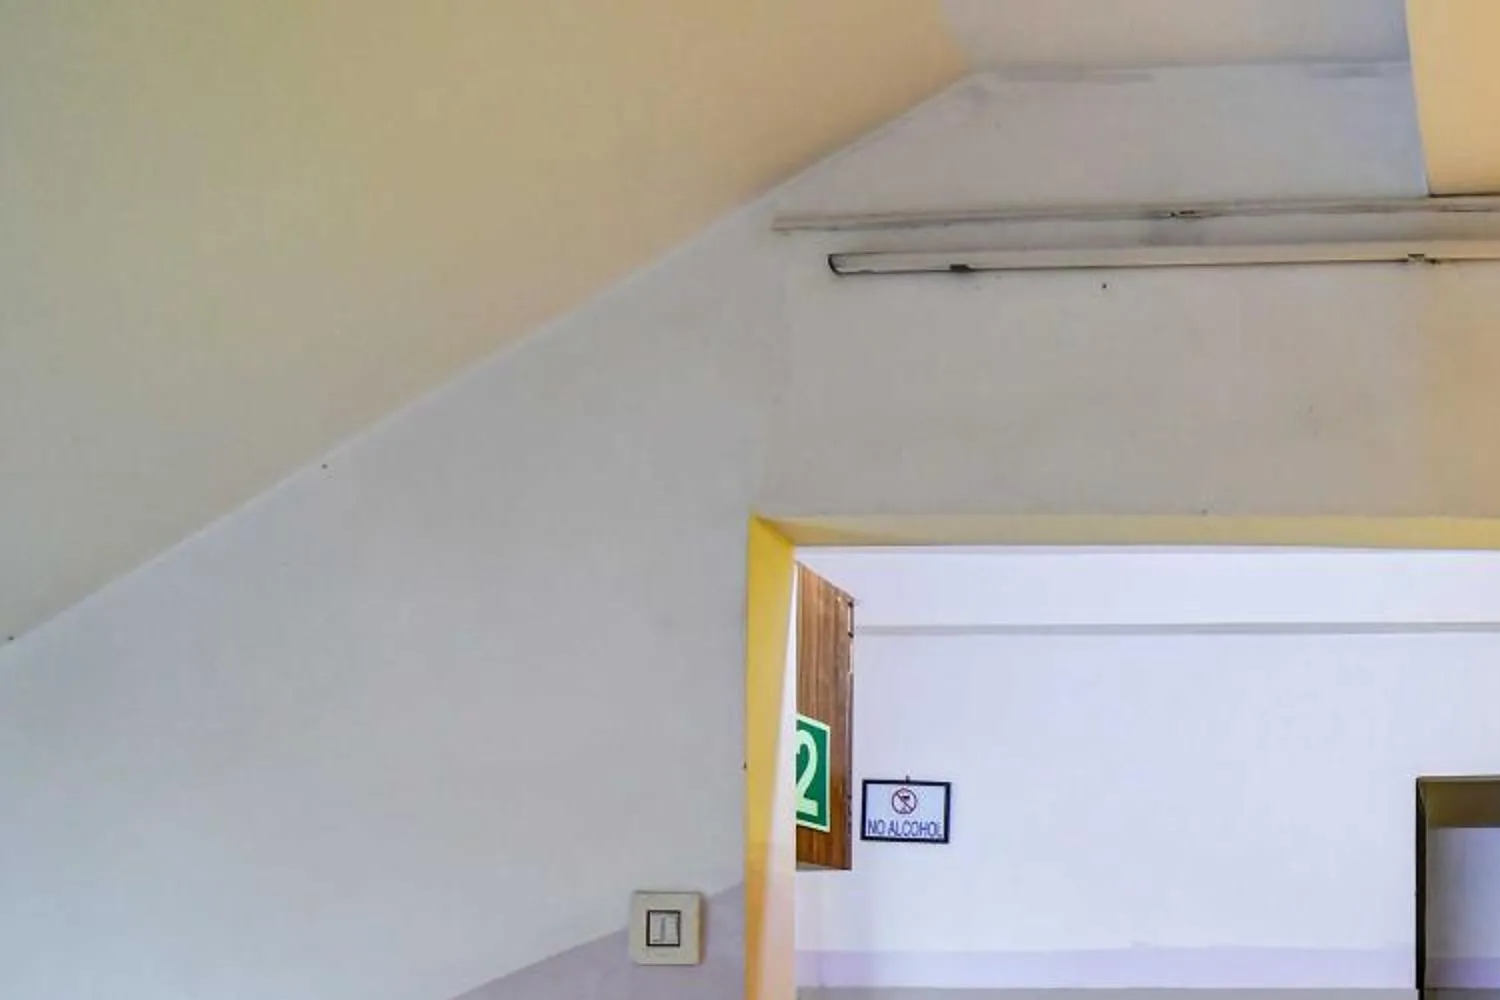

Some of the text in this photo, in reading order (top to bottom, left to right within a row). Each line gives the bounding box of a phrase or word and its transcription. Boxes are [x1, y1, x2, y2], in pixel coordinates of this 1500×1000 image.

[796, 729, 818, 817] 2
[867, 818, 943, 838] NO ALCOHOL
